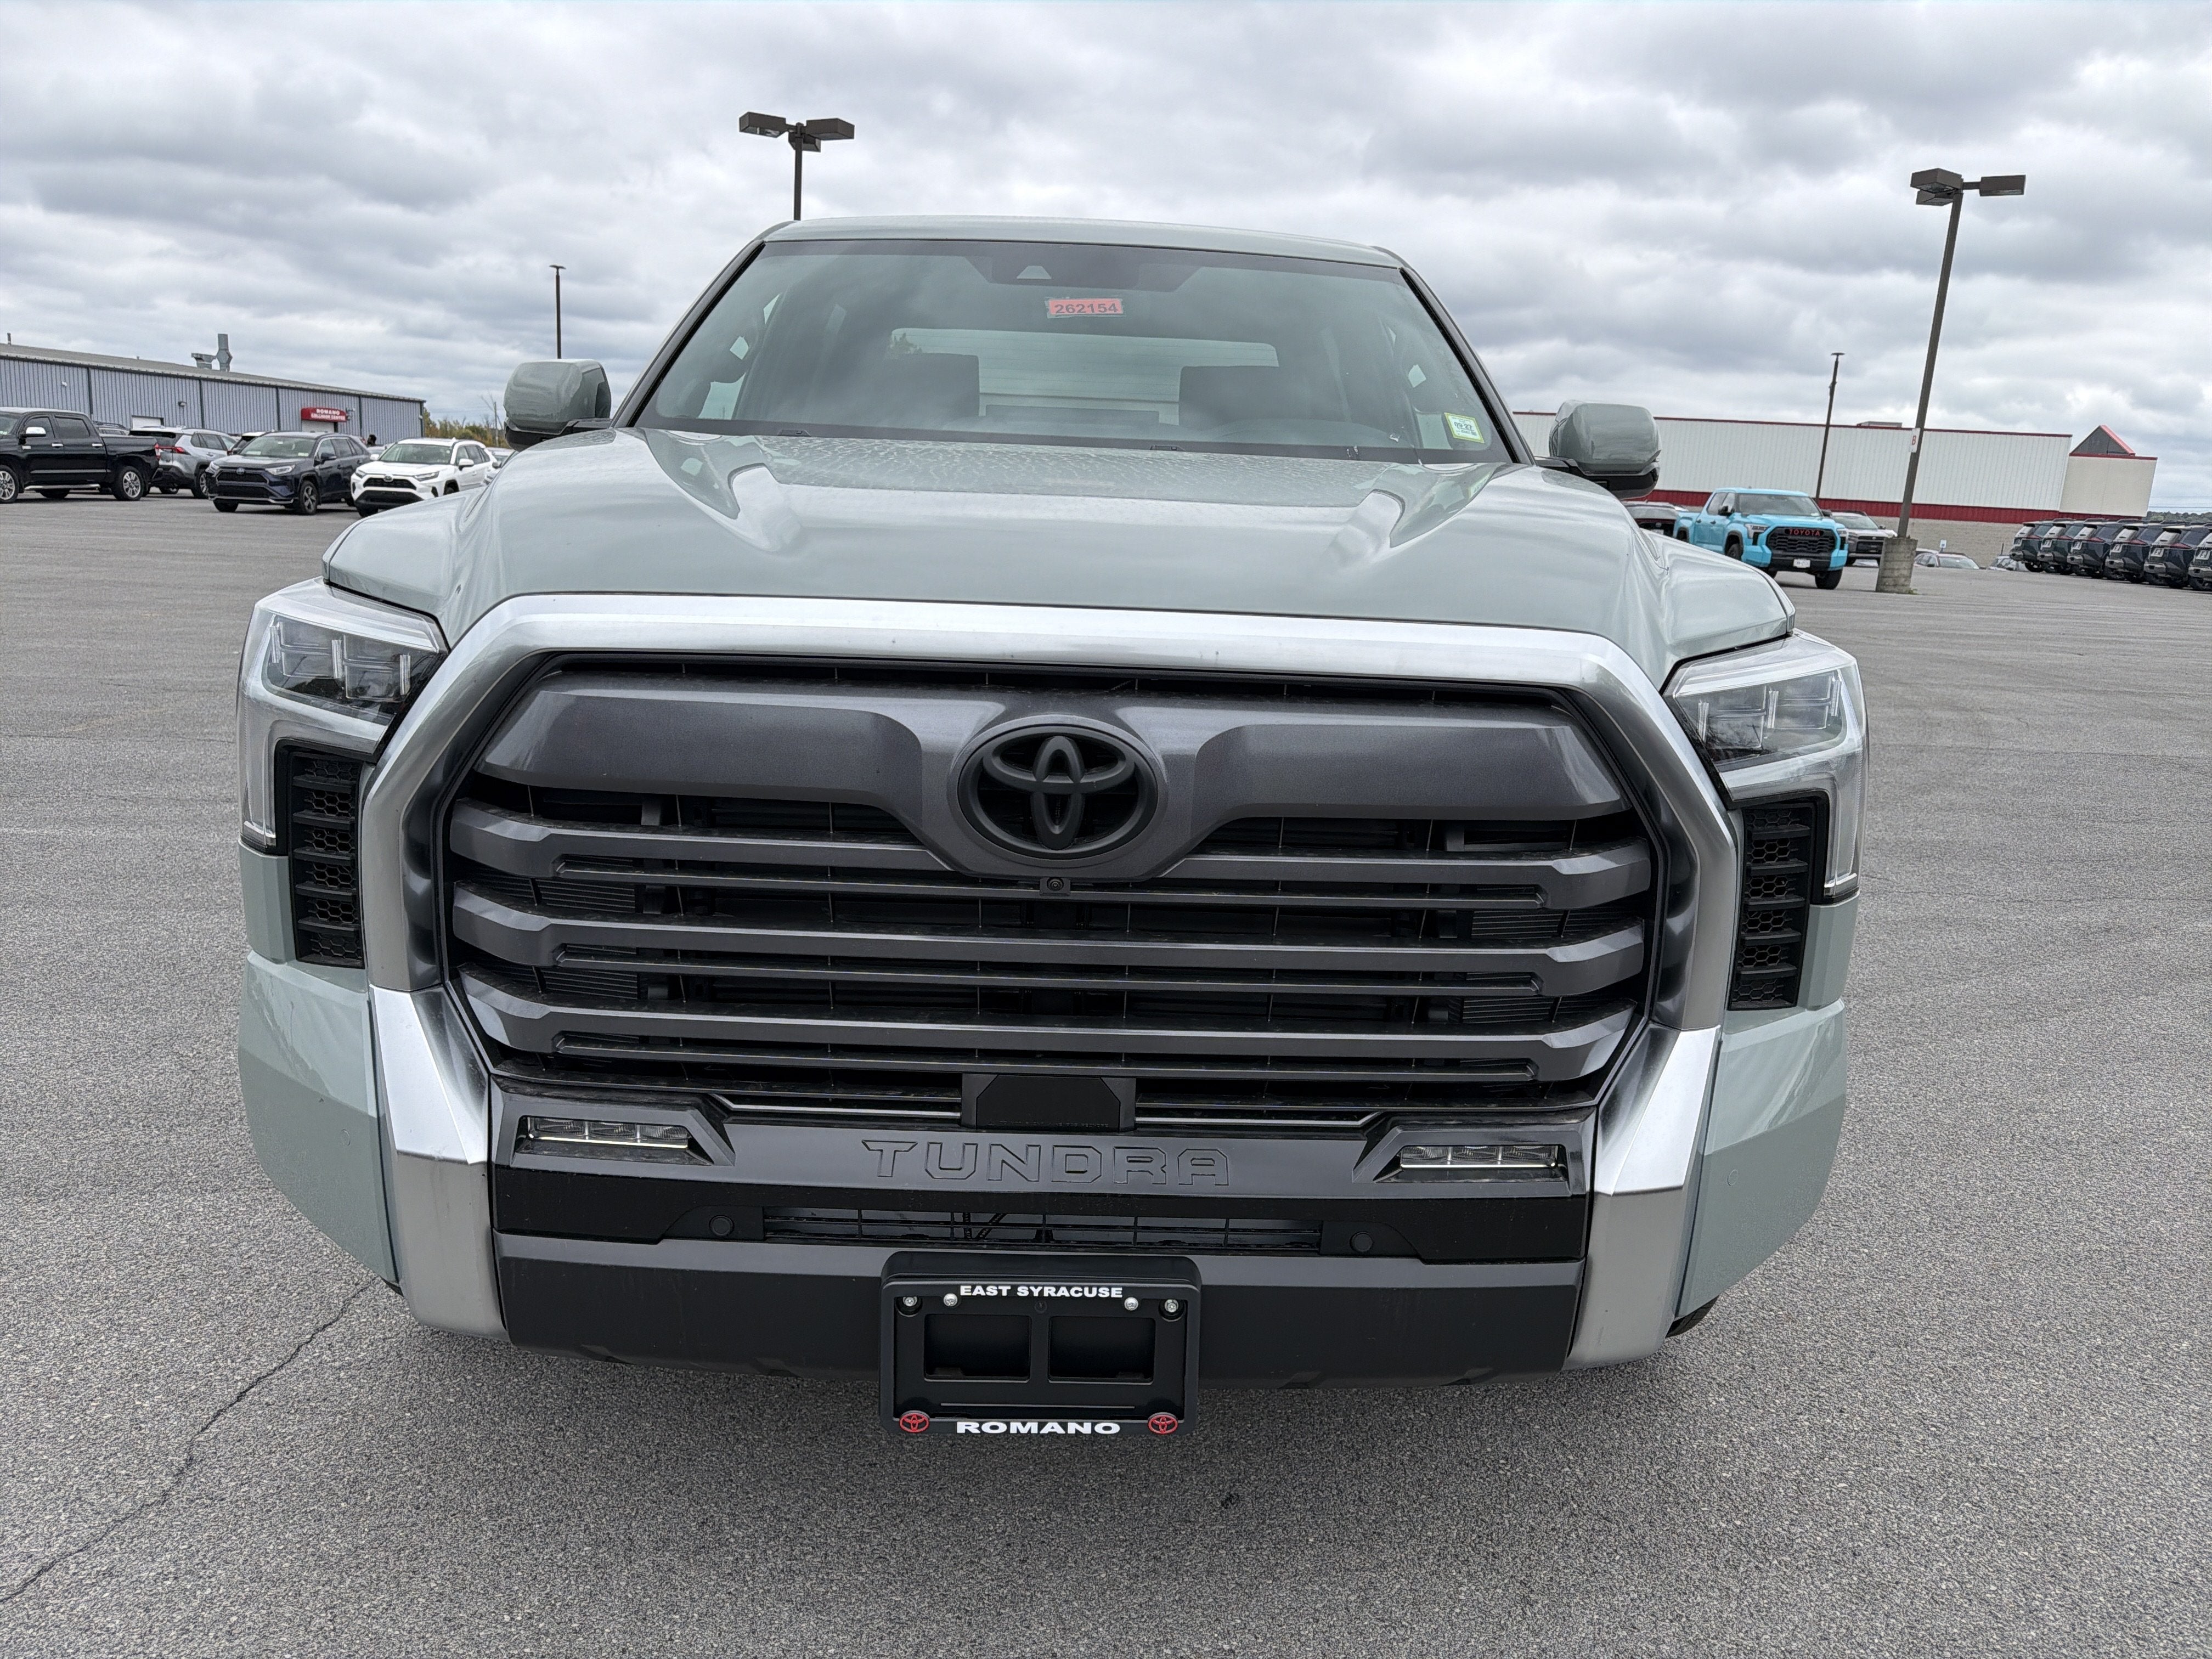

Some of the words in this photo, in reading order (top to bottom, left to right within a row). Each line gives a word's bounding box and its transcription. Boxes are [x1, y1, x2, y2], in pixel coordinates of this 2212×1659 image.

[1054, 303, 1118, 313] 262154
[862, 1139, 1229, 1186] TUNDRA
[960, 1285, 1011, 1296] EAST
[1017, 1286, 1122, 1298] SYRACUSE
[956, 1421, 1120, 1434] ROMANO
